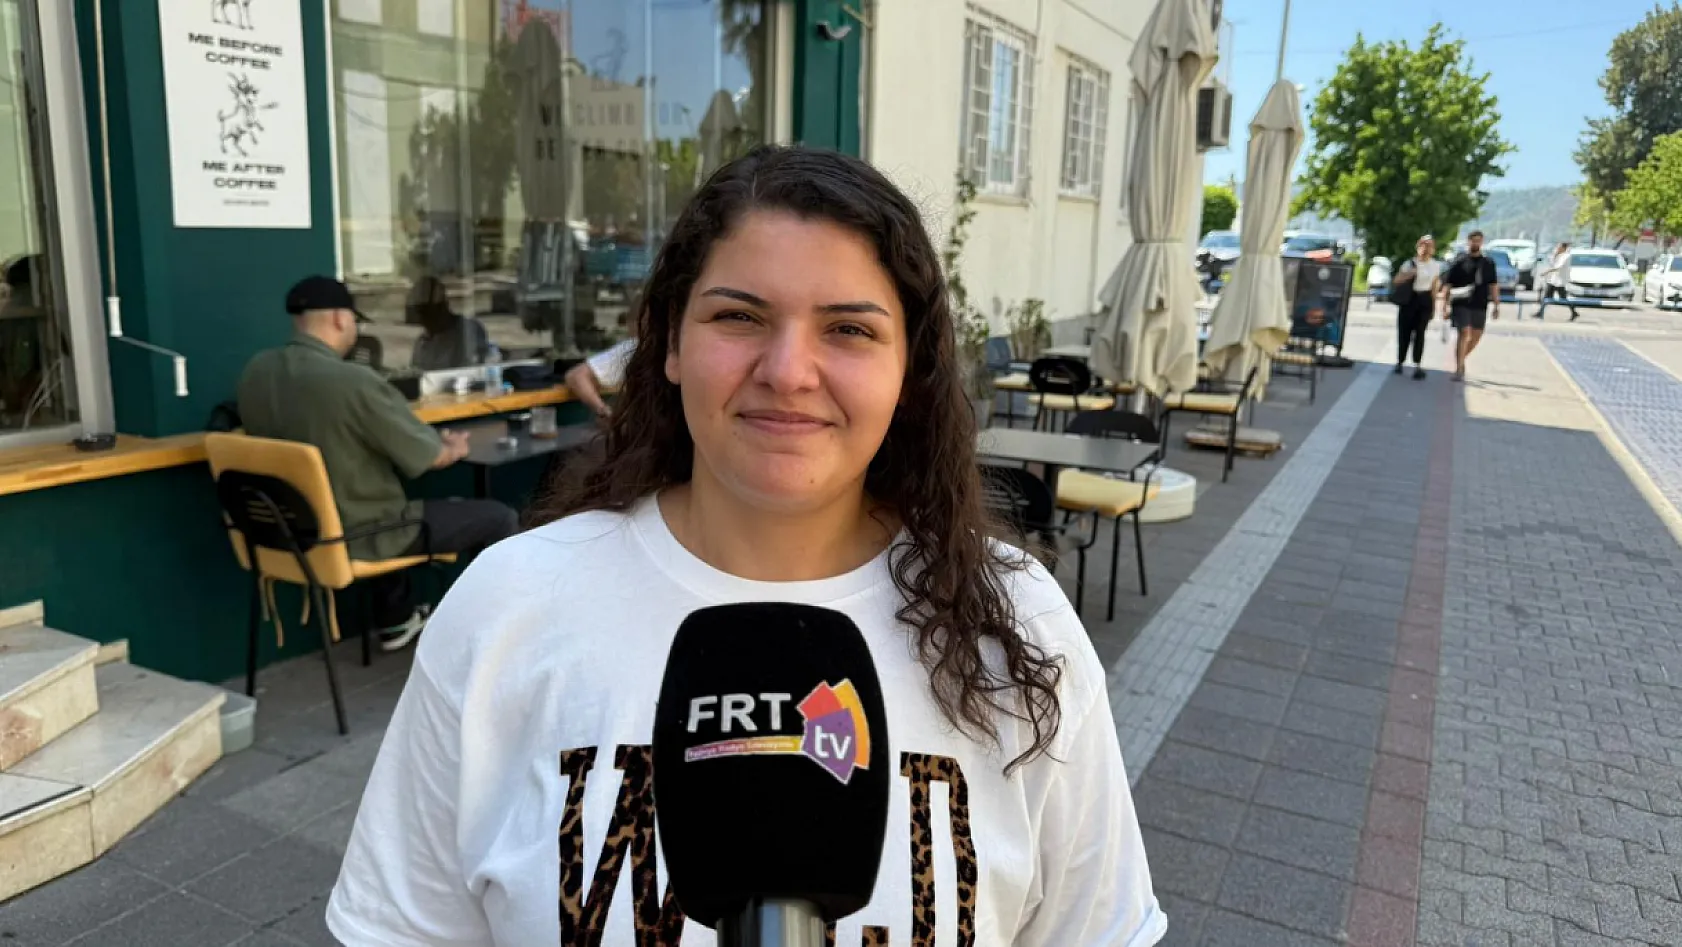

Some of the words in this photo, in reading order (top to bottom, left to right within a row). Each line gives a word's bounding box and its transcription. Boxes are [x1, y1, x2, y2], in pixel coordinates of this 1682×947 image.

[188, 32, 214, 45] ME
[219, 37, 283, 56] BEFORE
[205, 51, 270, 69] COFFEE
[202, 160, 227, 171] ME
[233, 163, 285, 174] AFTER
[214, 177, 276, 189] COFFEE
[687, 693, 791, 732] FRT
[815, 725, 852, 760] tv
[560, 743, 978, 947] WD
